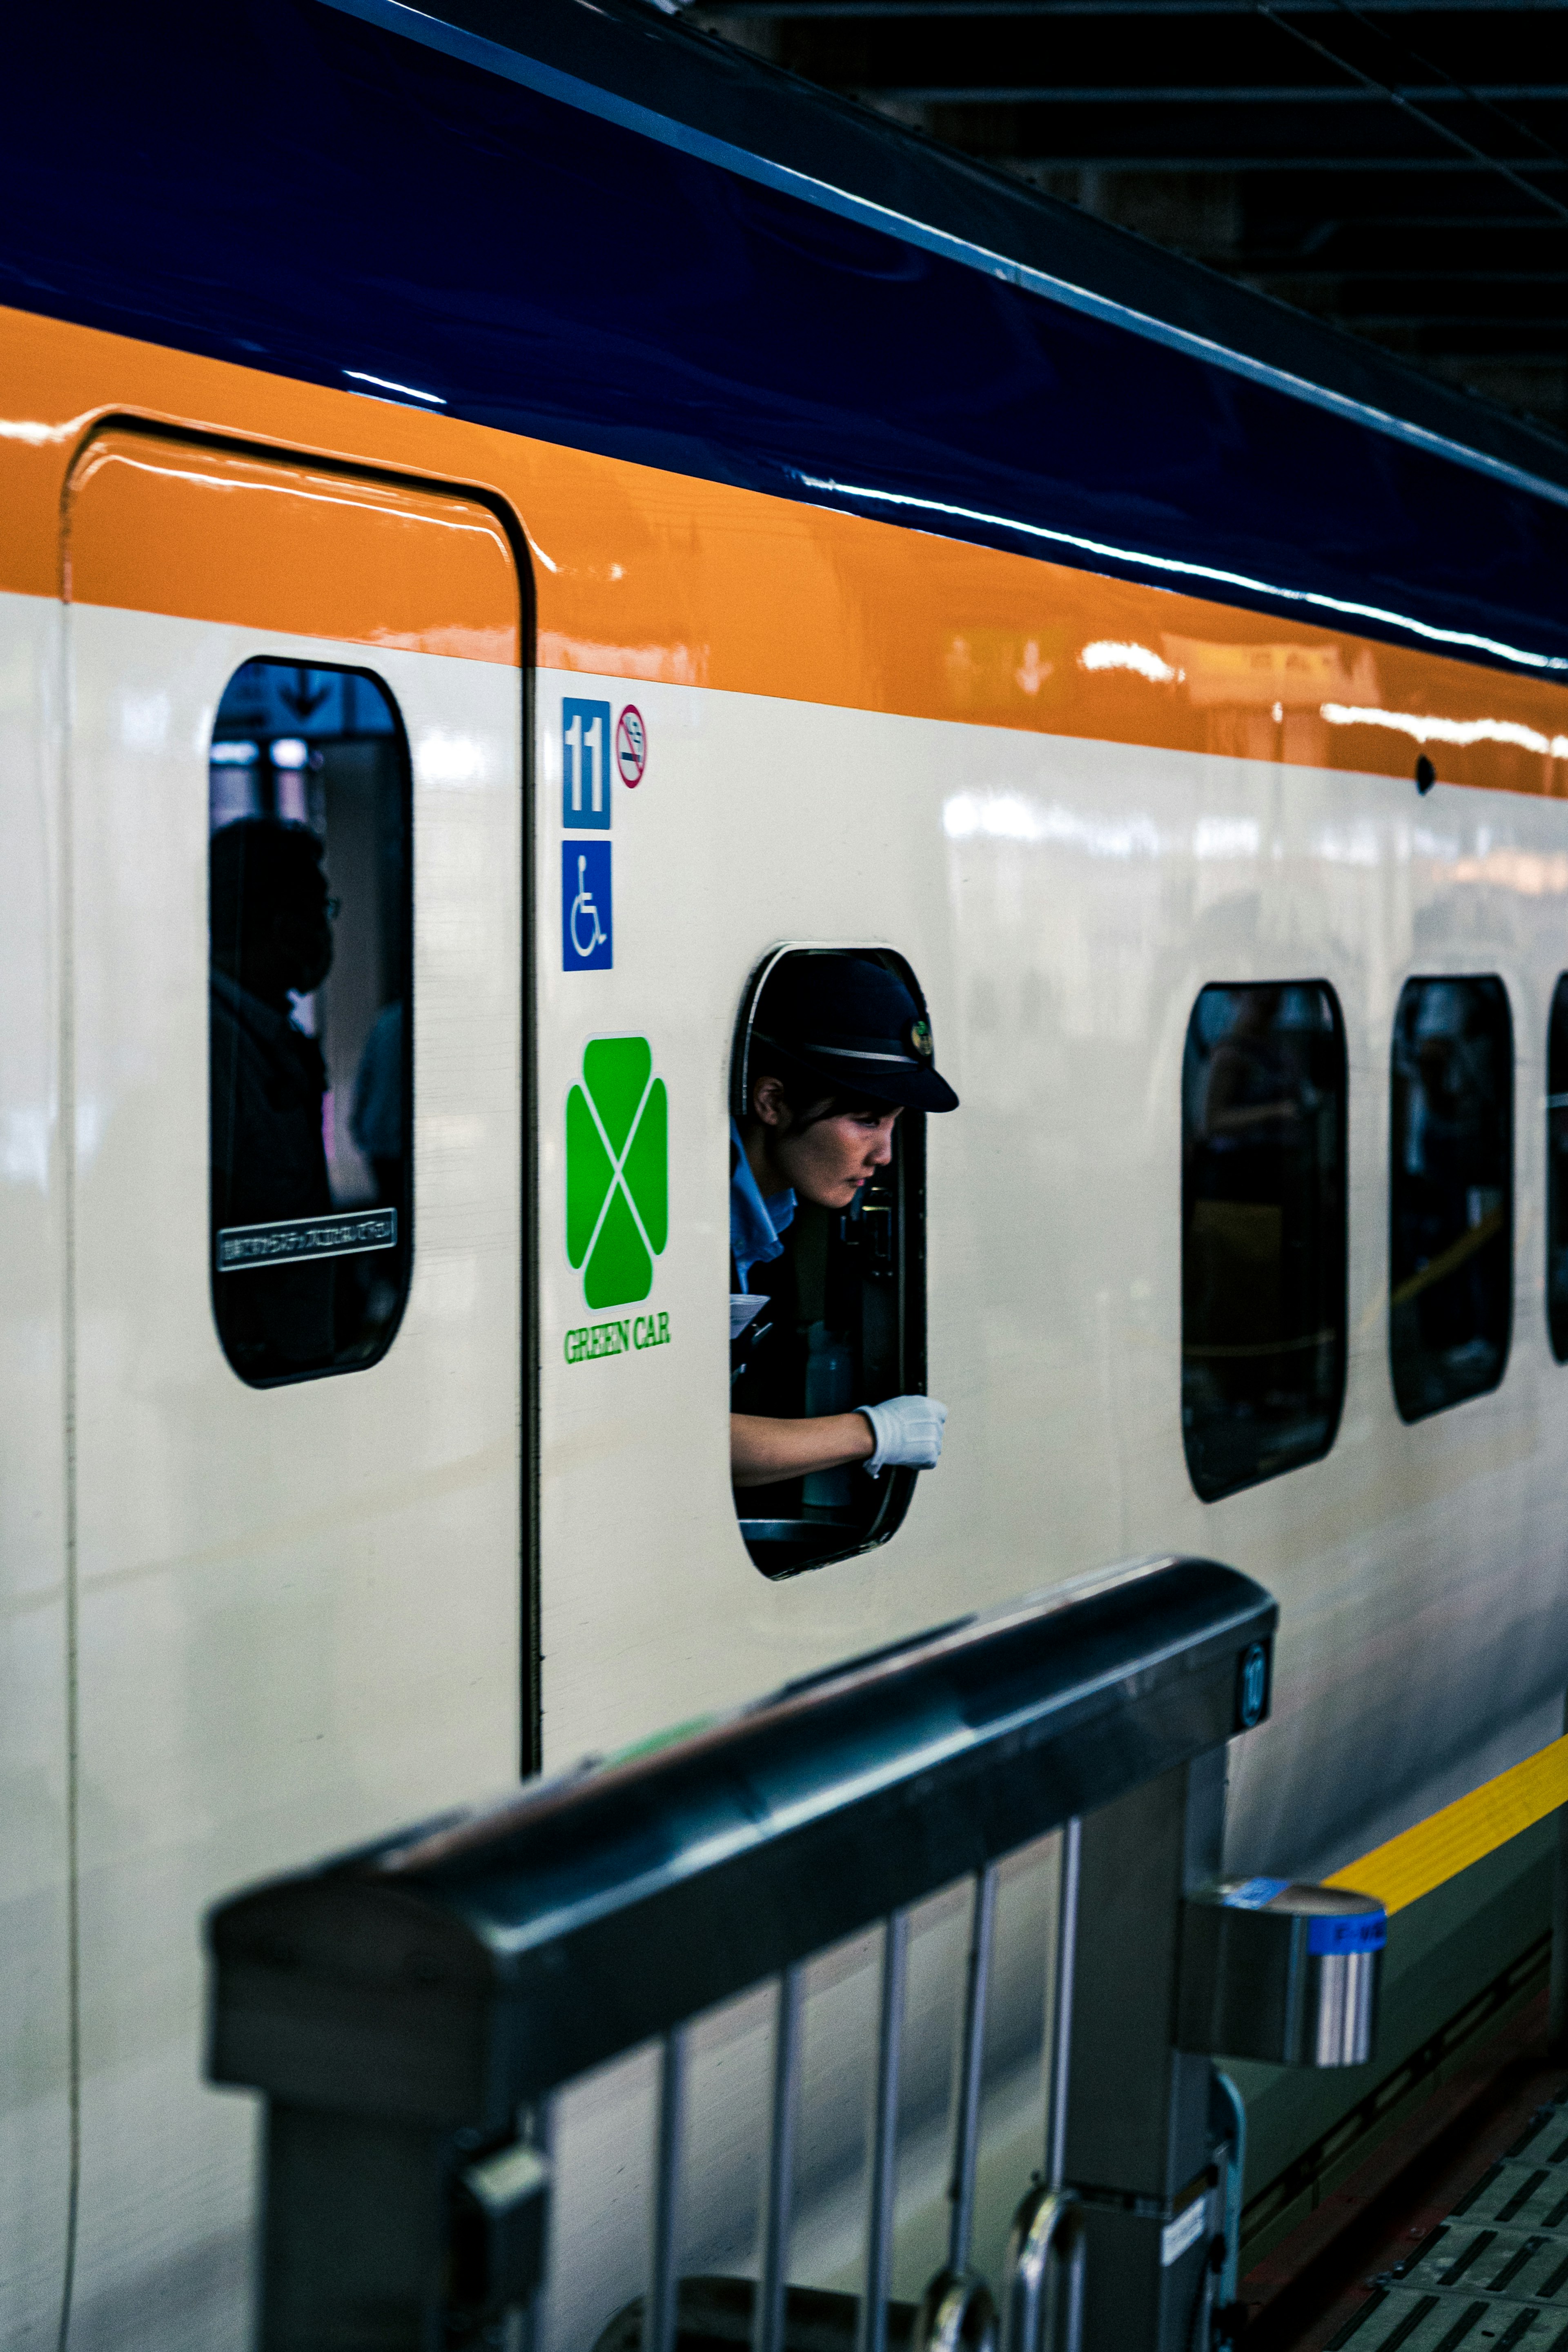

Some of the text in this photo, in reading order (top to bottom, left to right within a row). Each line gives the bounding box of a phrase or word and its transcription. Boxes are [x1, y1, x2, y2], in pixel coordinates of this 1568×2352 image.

[565, 715, 603, 812] 11
[564, 1311, 671, 1364] GREEN CAR
